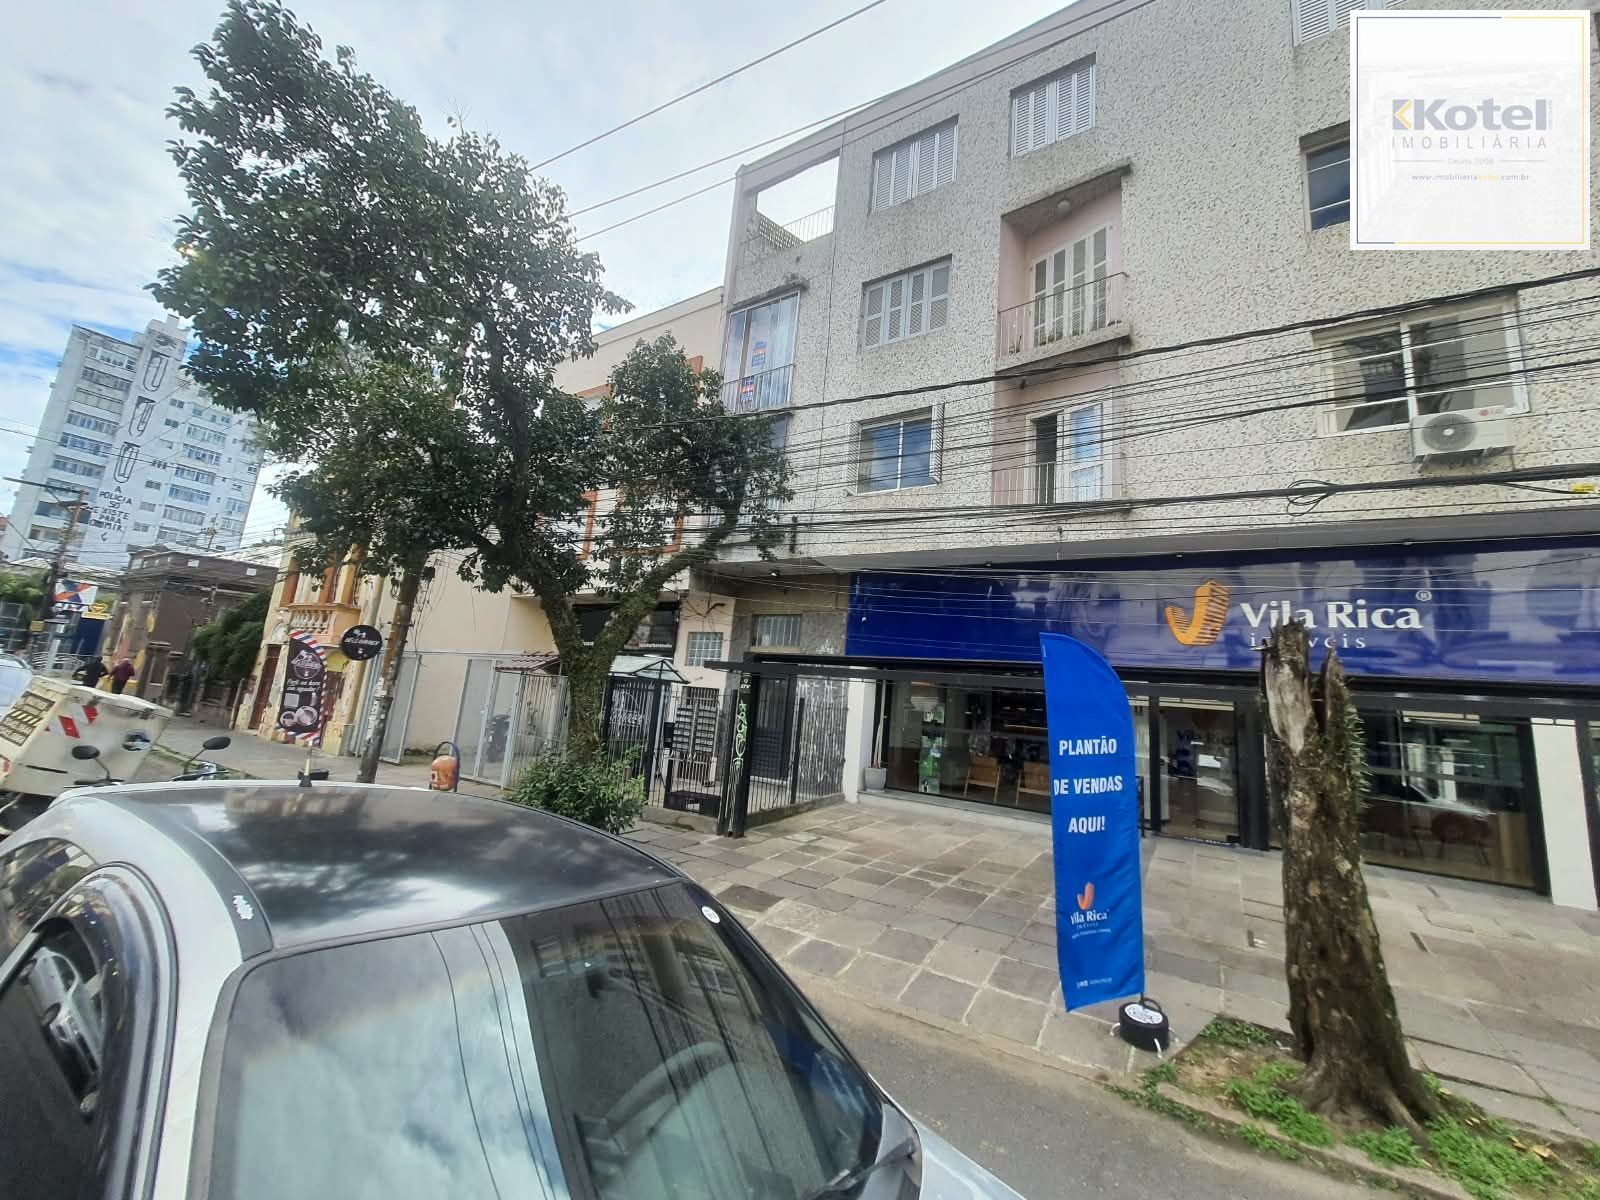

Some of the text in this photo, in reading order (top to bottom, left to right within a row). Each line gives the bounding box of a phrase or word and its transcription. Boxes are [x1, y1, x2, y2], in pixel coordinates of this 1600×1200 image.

[1240, 600, 1318, 630] Vila
[1327, 598, 1425, 629] Rica
[1250, 634, 1367, 649] iveis
[1058, 735, 1118, 756] PLANTÃO
[1053, 775, 1123, 796] DE VENDAS
[1067, 815, 1105, 834] AQUI!
[1086, 909, 1108, 922] Rica
